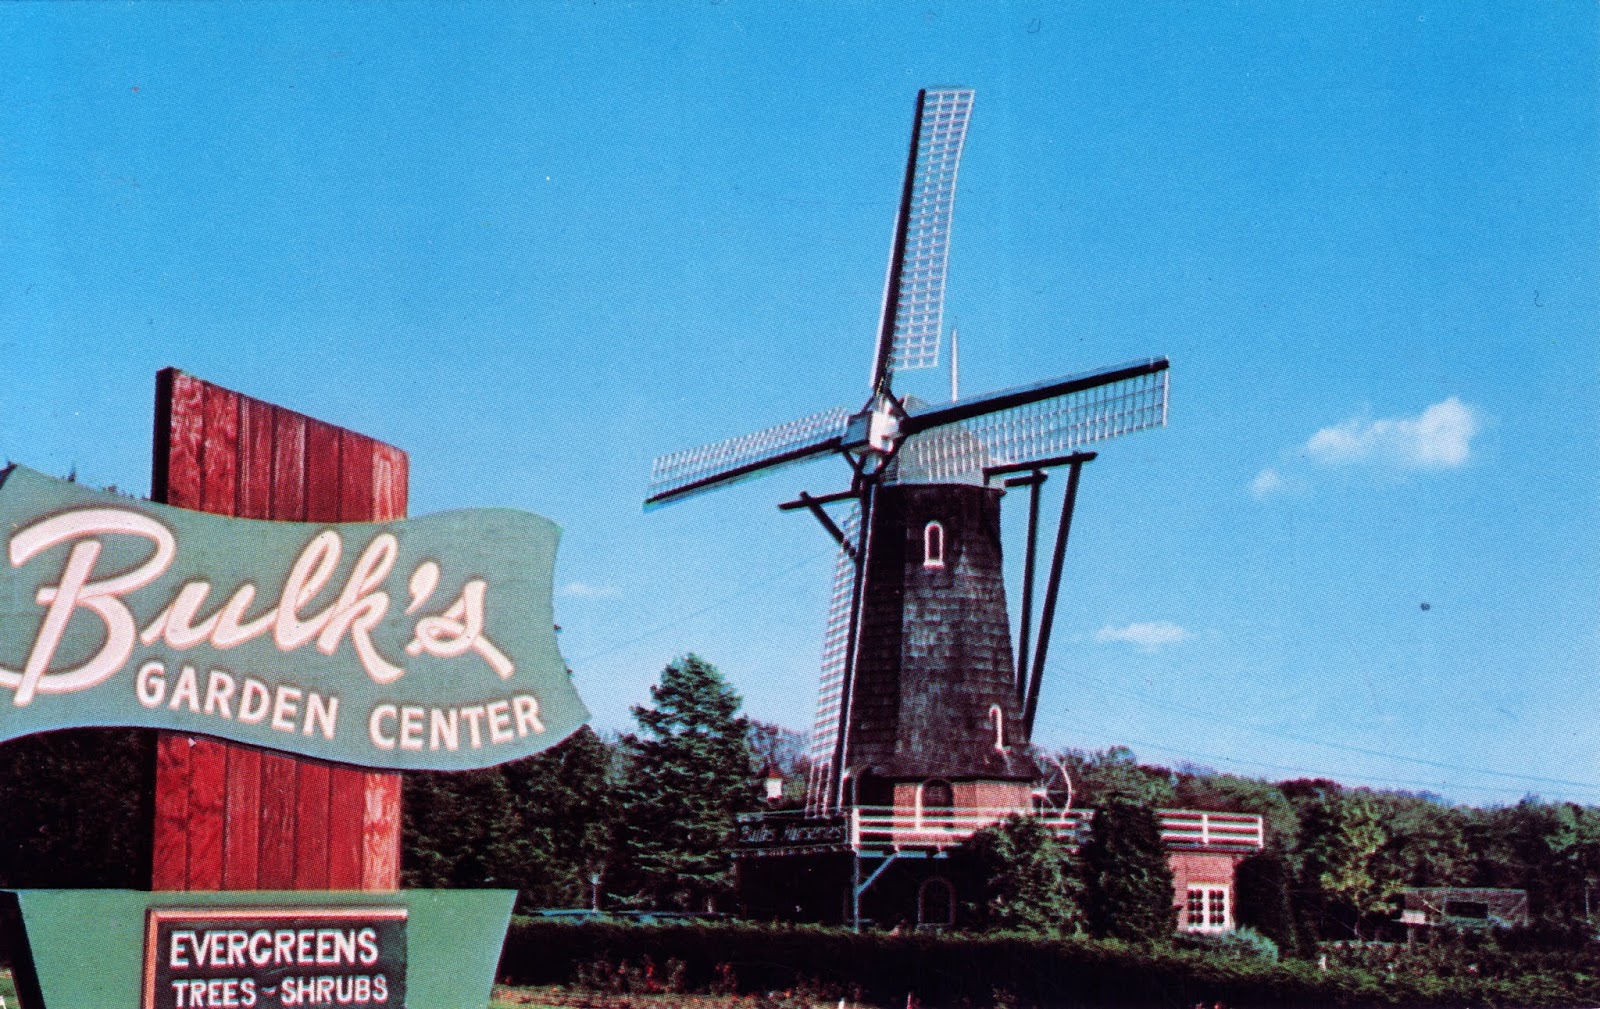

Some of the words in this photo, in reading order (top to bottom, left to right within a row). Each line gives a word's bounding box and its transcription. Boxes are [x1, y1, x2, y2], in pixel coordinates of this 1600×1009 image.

[0, 508, 514, 706] Bulk's
[136, 661, 338, 740] GARDEN
[370, 694, 546, 751] CENTER
[170, 928, 379, 969] EVERGREENS
[171, 977, 257, 1009] TREES
[281, 973, 389, 1005] SHRUBS
